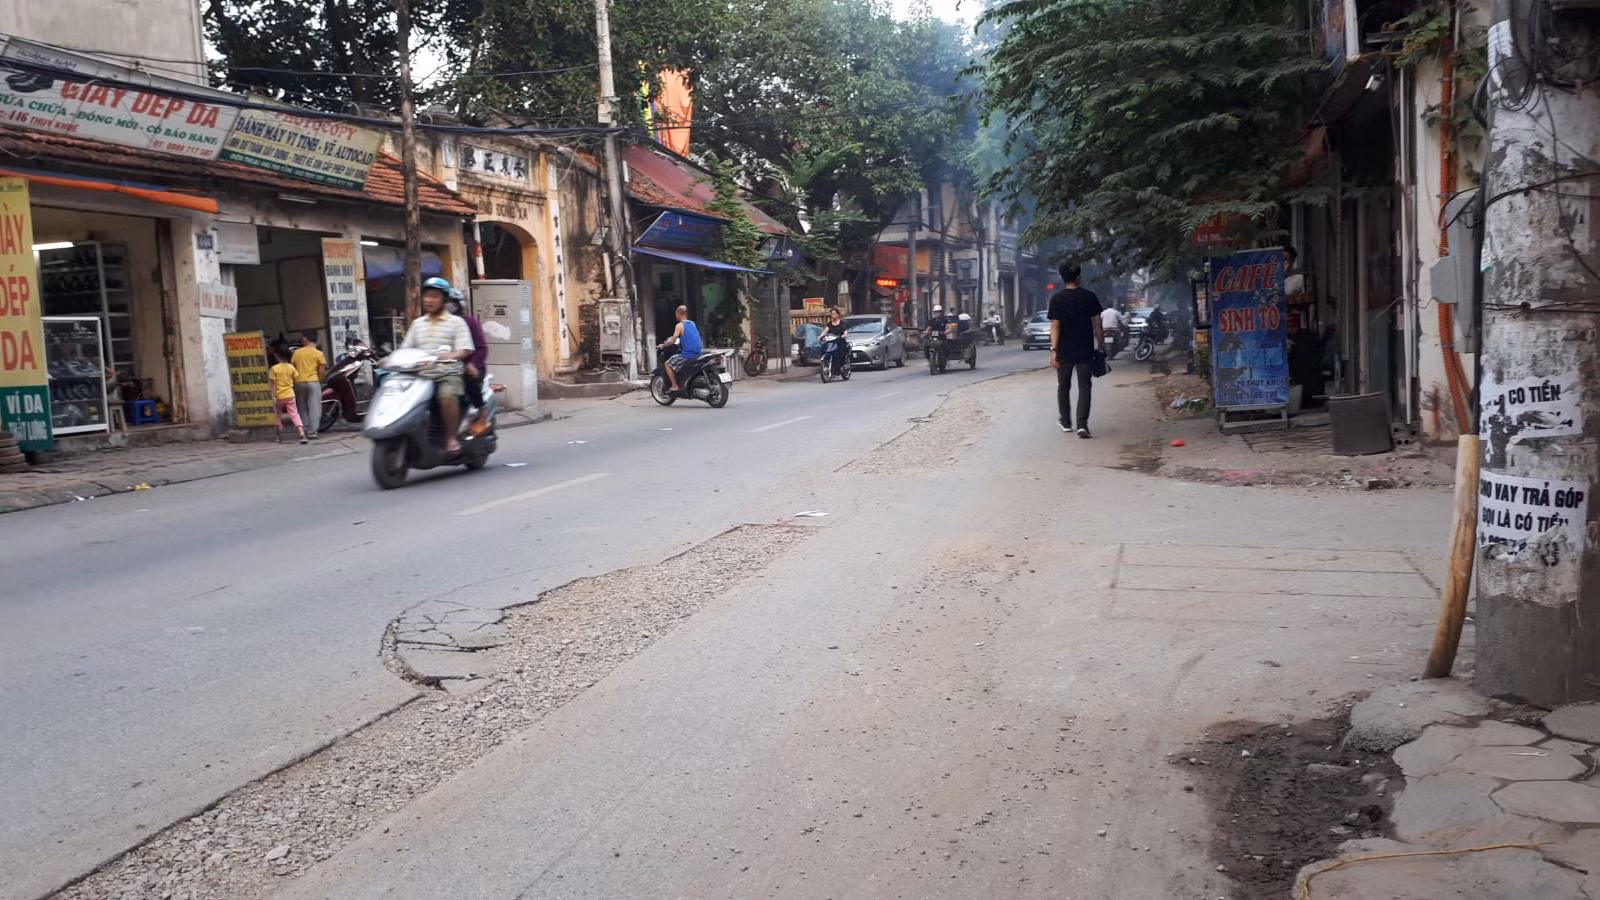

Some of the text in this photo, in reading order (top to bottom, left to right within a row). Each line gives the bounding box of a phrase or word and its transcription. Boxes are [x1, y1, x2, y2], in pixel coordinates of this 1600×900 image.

[1218, 307, 1256, 332] SINH
[1, 330, 37, 371] DA
[24, 394, 44, 414] DA
[1495, 483, 1518, 502] VAY
[1522, 481, 1550, 507] TRẢ
[1555, 487, 1584, 509] GÓP
[1497, 508, 1511, 528] LÀ
[1515, 512, 1533, 532] CÓ
[1537, 512, 1569, 533] TIỀ
